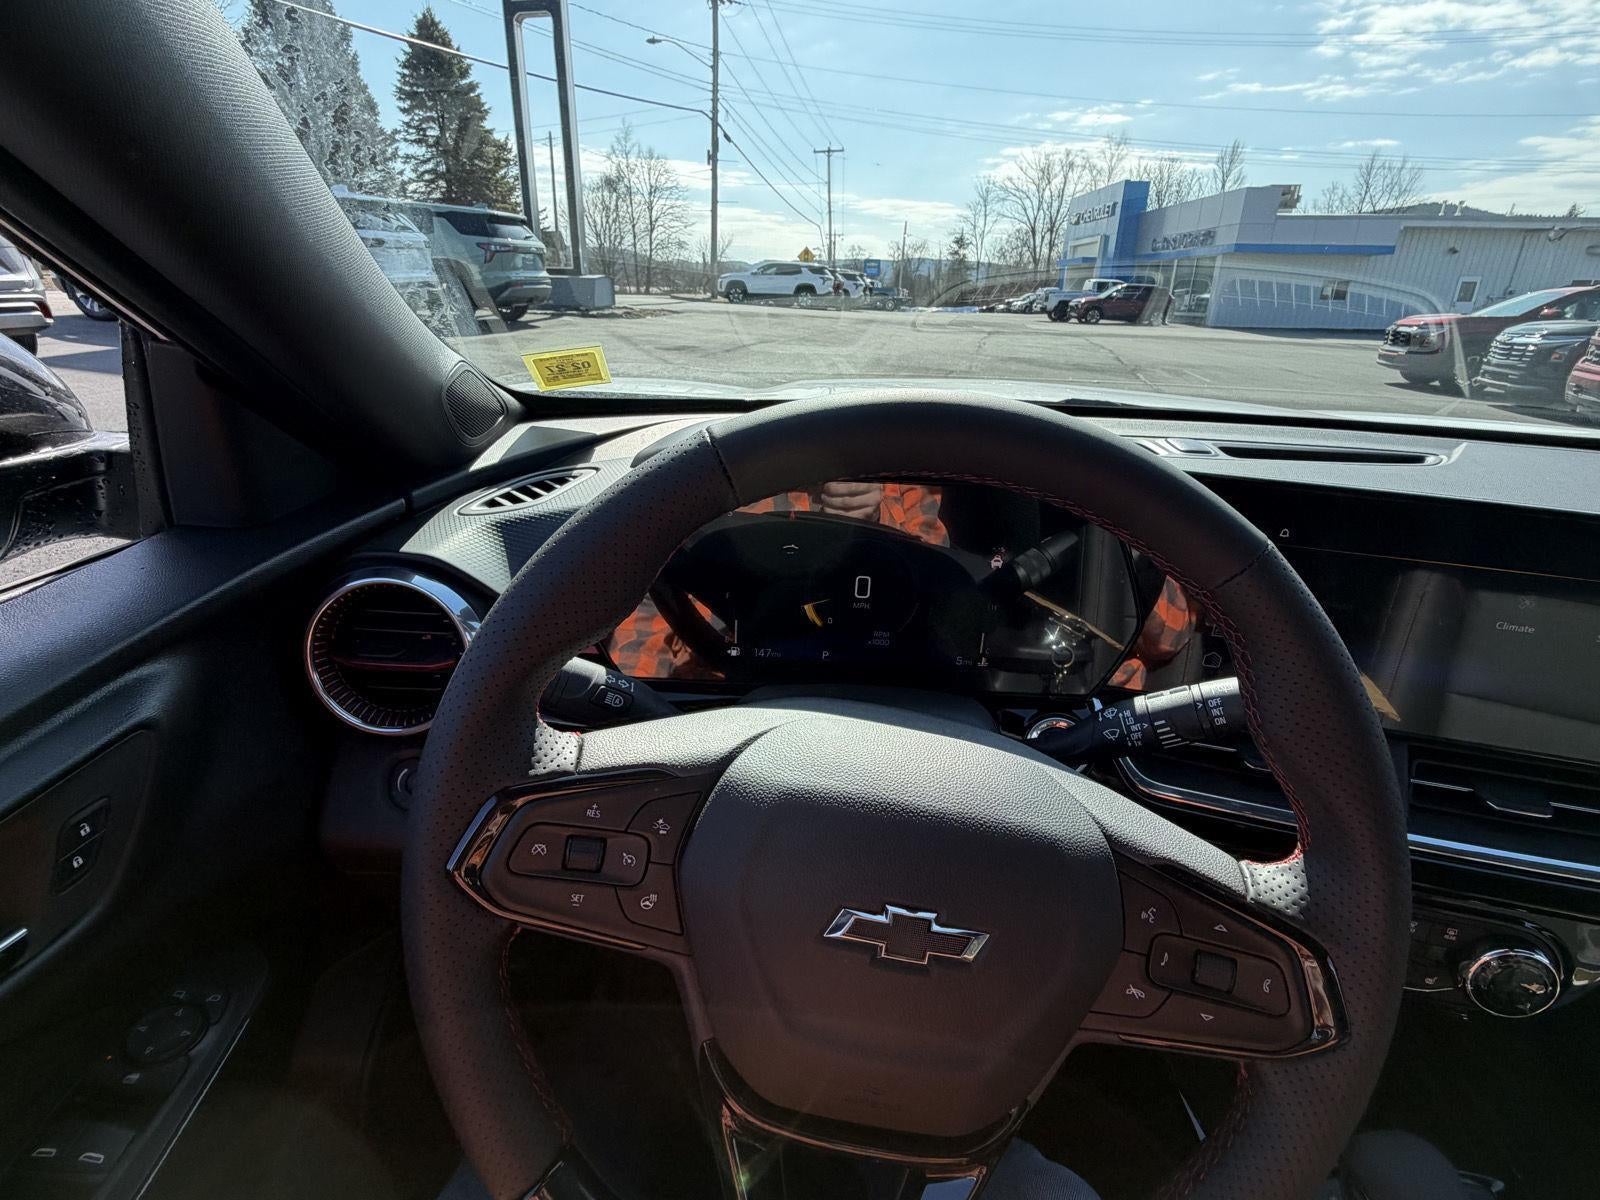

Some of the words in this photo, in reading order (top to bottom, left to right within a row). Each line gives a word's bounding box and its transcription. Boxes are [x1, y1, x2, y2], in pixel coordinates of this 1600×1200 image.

[854, 575, 871, 599] 0
[1495, 621, 1535, 634] Climate
[1208, 697, 1221, 708] OFF
[1211, 706, 1224, 717] INT
[1125, 717, 1135, 725] LO
[1214, 716, 1227, 726] ON
[586, 809, 601, 818] RES
[570, 893, 584, 903] SET
